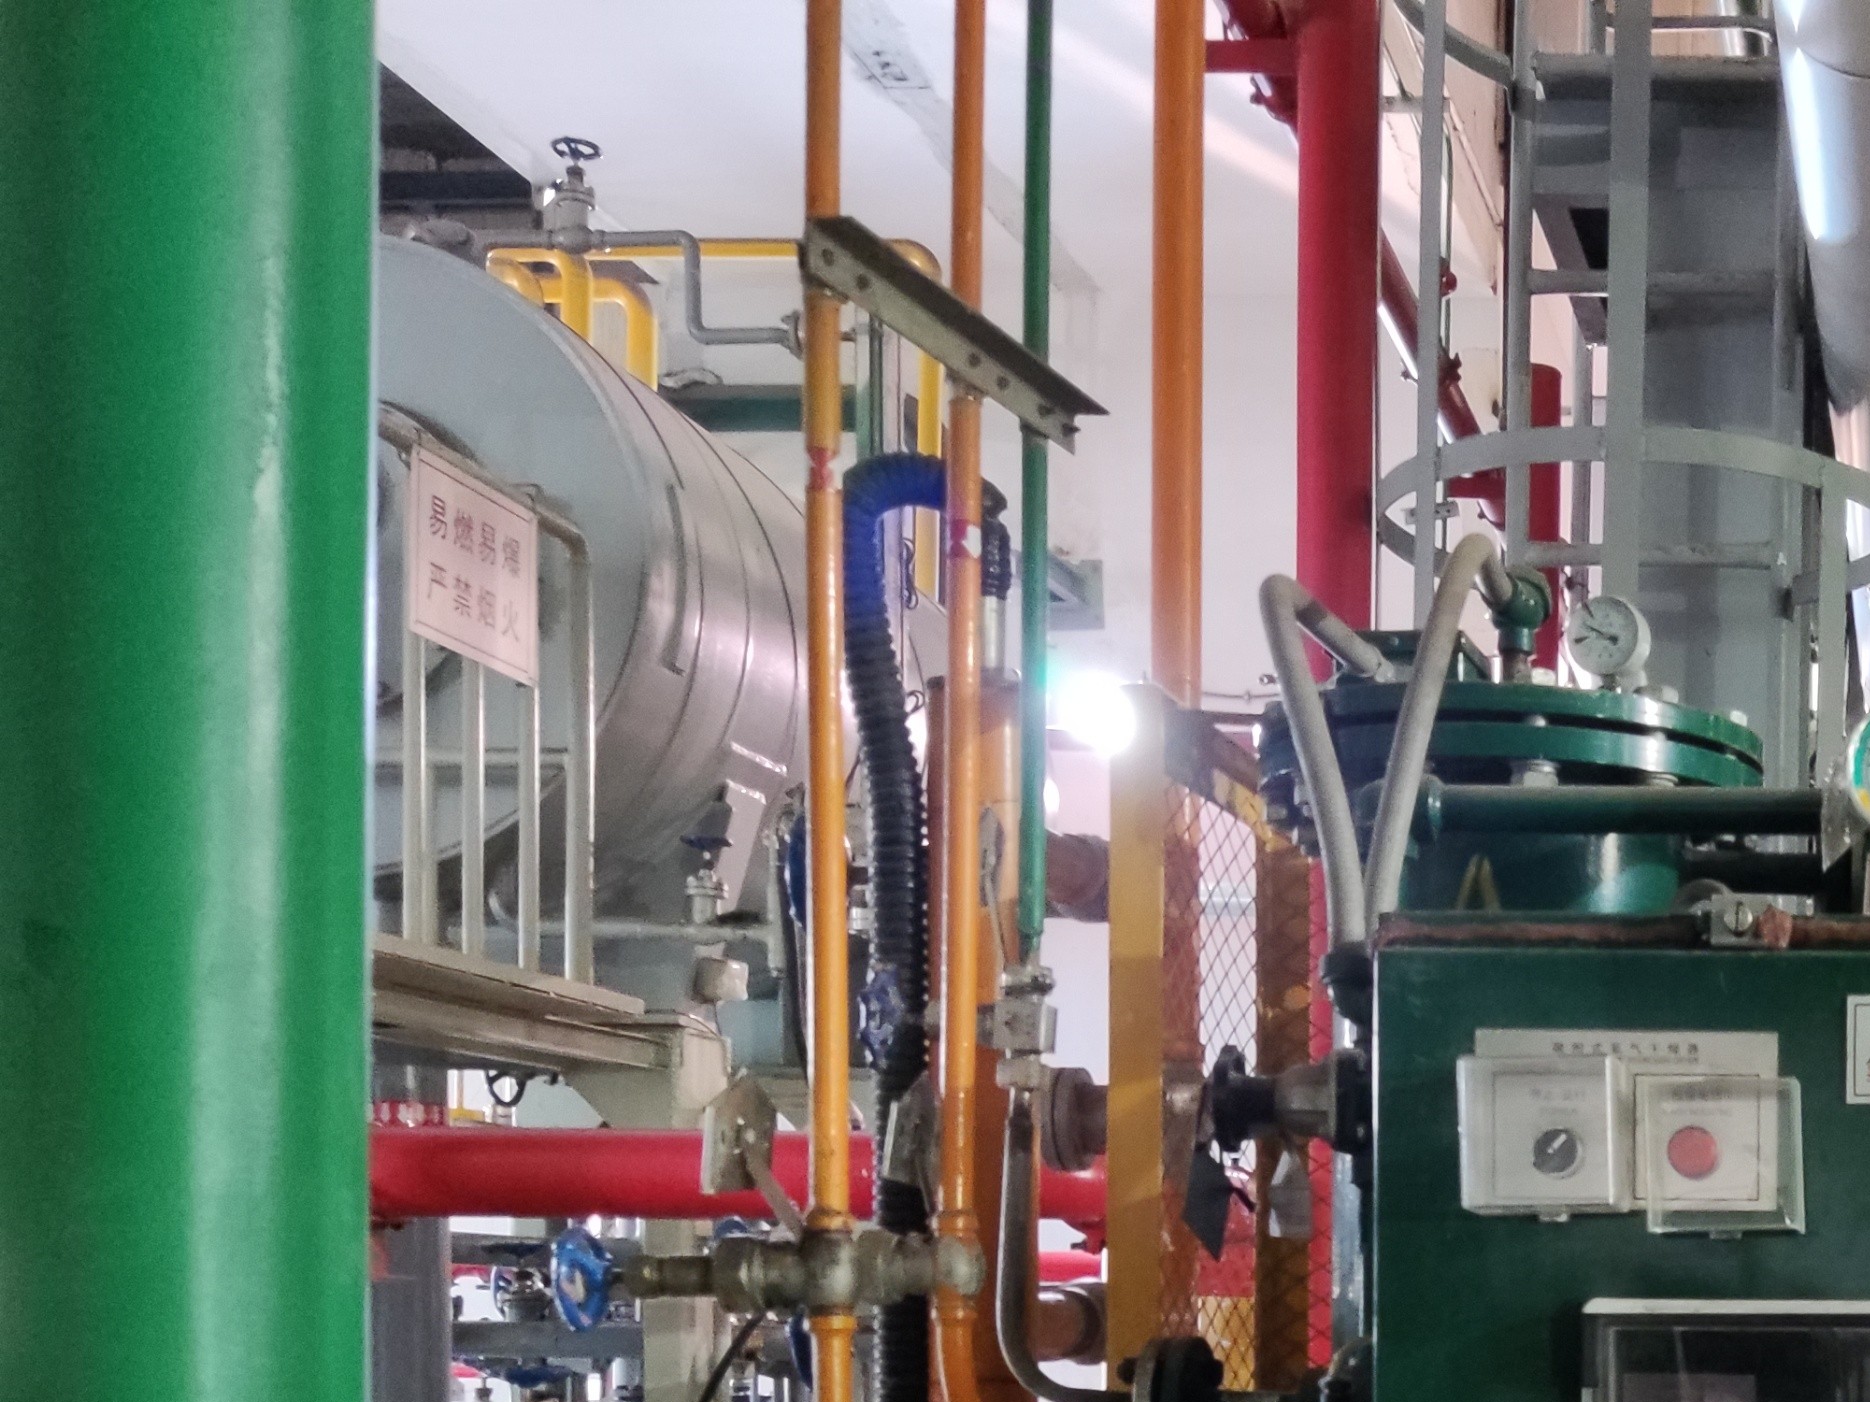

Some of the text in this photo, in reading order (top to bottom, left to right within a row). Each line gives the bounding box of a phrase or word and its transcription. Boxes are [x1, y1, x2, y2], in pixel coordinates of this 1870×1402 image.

[428, 495, 522, 579] 易燃易爆
[427, 562, 521, 644] 严禁烟火
